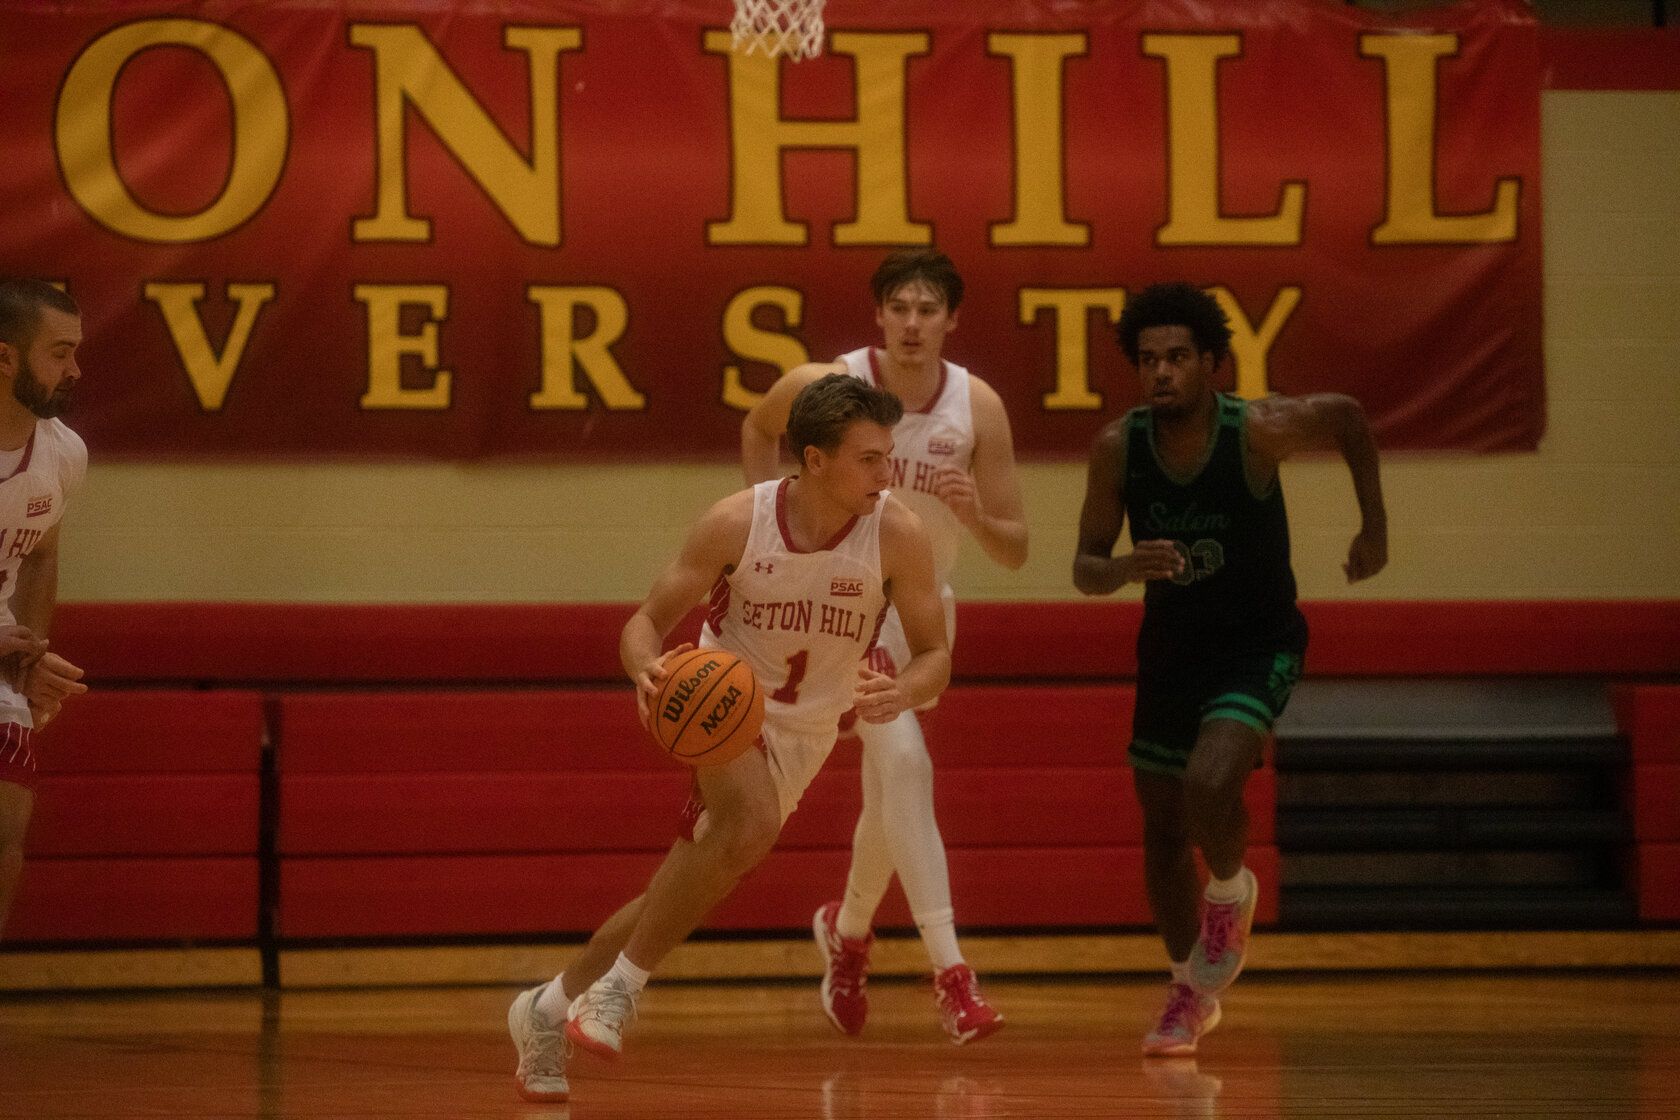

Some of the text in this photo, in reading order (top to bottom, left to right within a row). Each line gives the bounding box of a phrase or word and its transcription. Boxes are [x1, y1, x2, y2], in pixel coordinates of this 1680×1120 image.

[56, 20, 1519, 246] ON HILL
[46, 282, 1302, 411] VERSTY
[888, 457, 908, 488] N
[27, 498, 53, 513] PSAC
[1145, 499, 1229, 532] Salem
[831, 582, 863, 592] PSAC
[743, 599, 812, 634] SETON
[663, 660, 721, 723] Wilson
[770, 649, 808, 704] 1
[701, 685, 742, 736] NCAA
